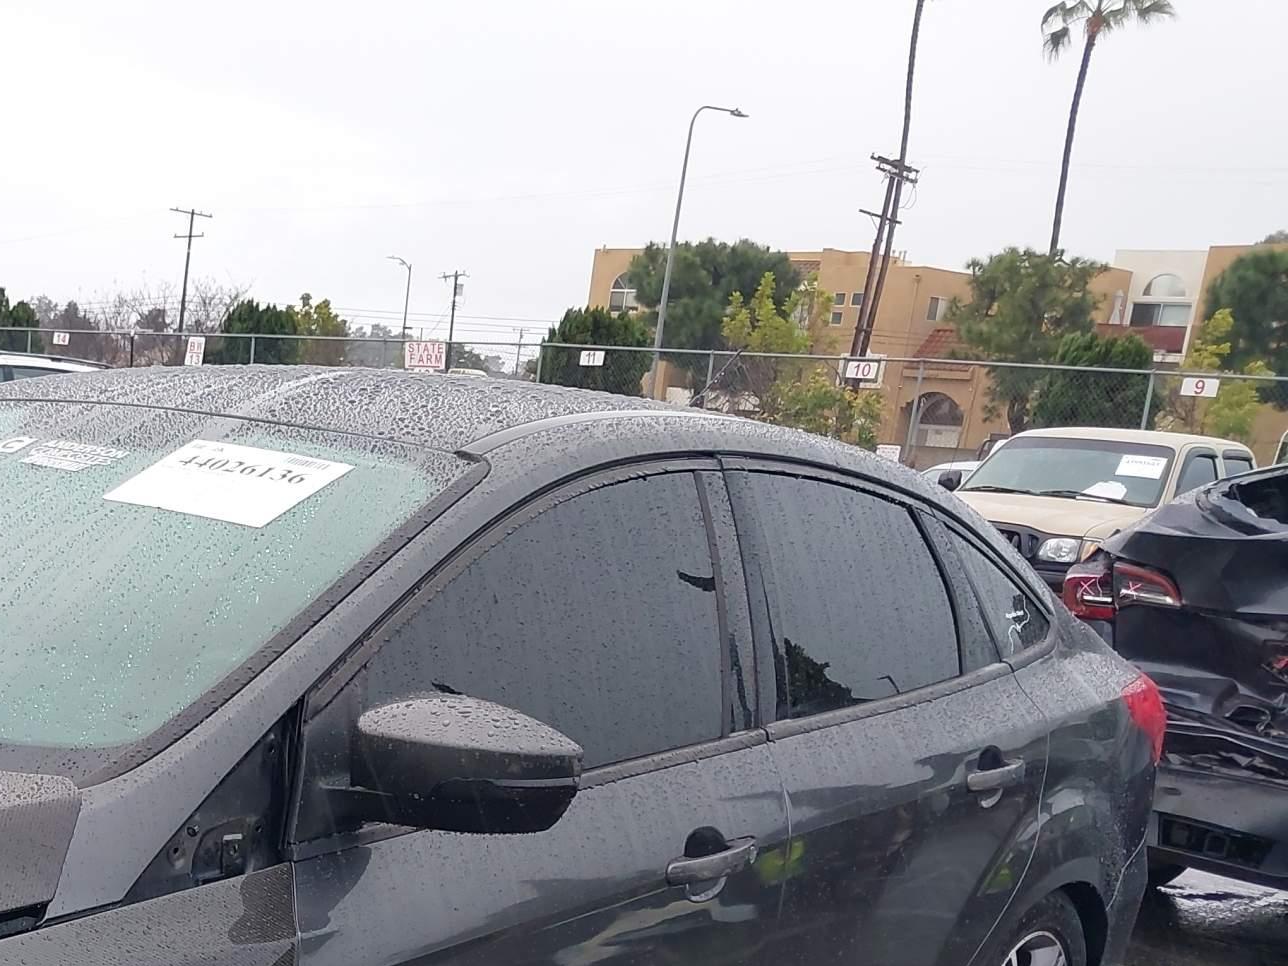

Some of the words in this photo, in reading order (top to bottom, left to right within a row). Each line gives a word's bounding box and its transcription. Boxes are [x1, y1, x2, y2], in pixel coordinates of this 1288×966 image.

[408, 343, 444, 354] STATE
[409, 354, 443, 365] FARM
[585, 351, 596, 364] 11
[854, 363, 871, 377] 10
[1193, 379, 1206, 395] 9
[178, 454, 307, 485] 44026136
